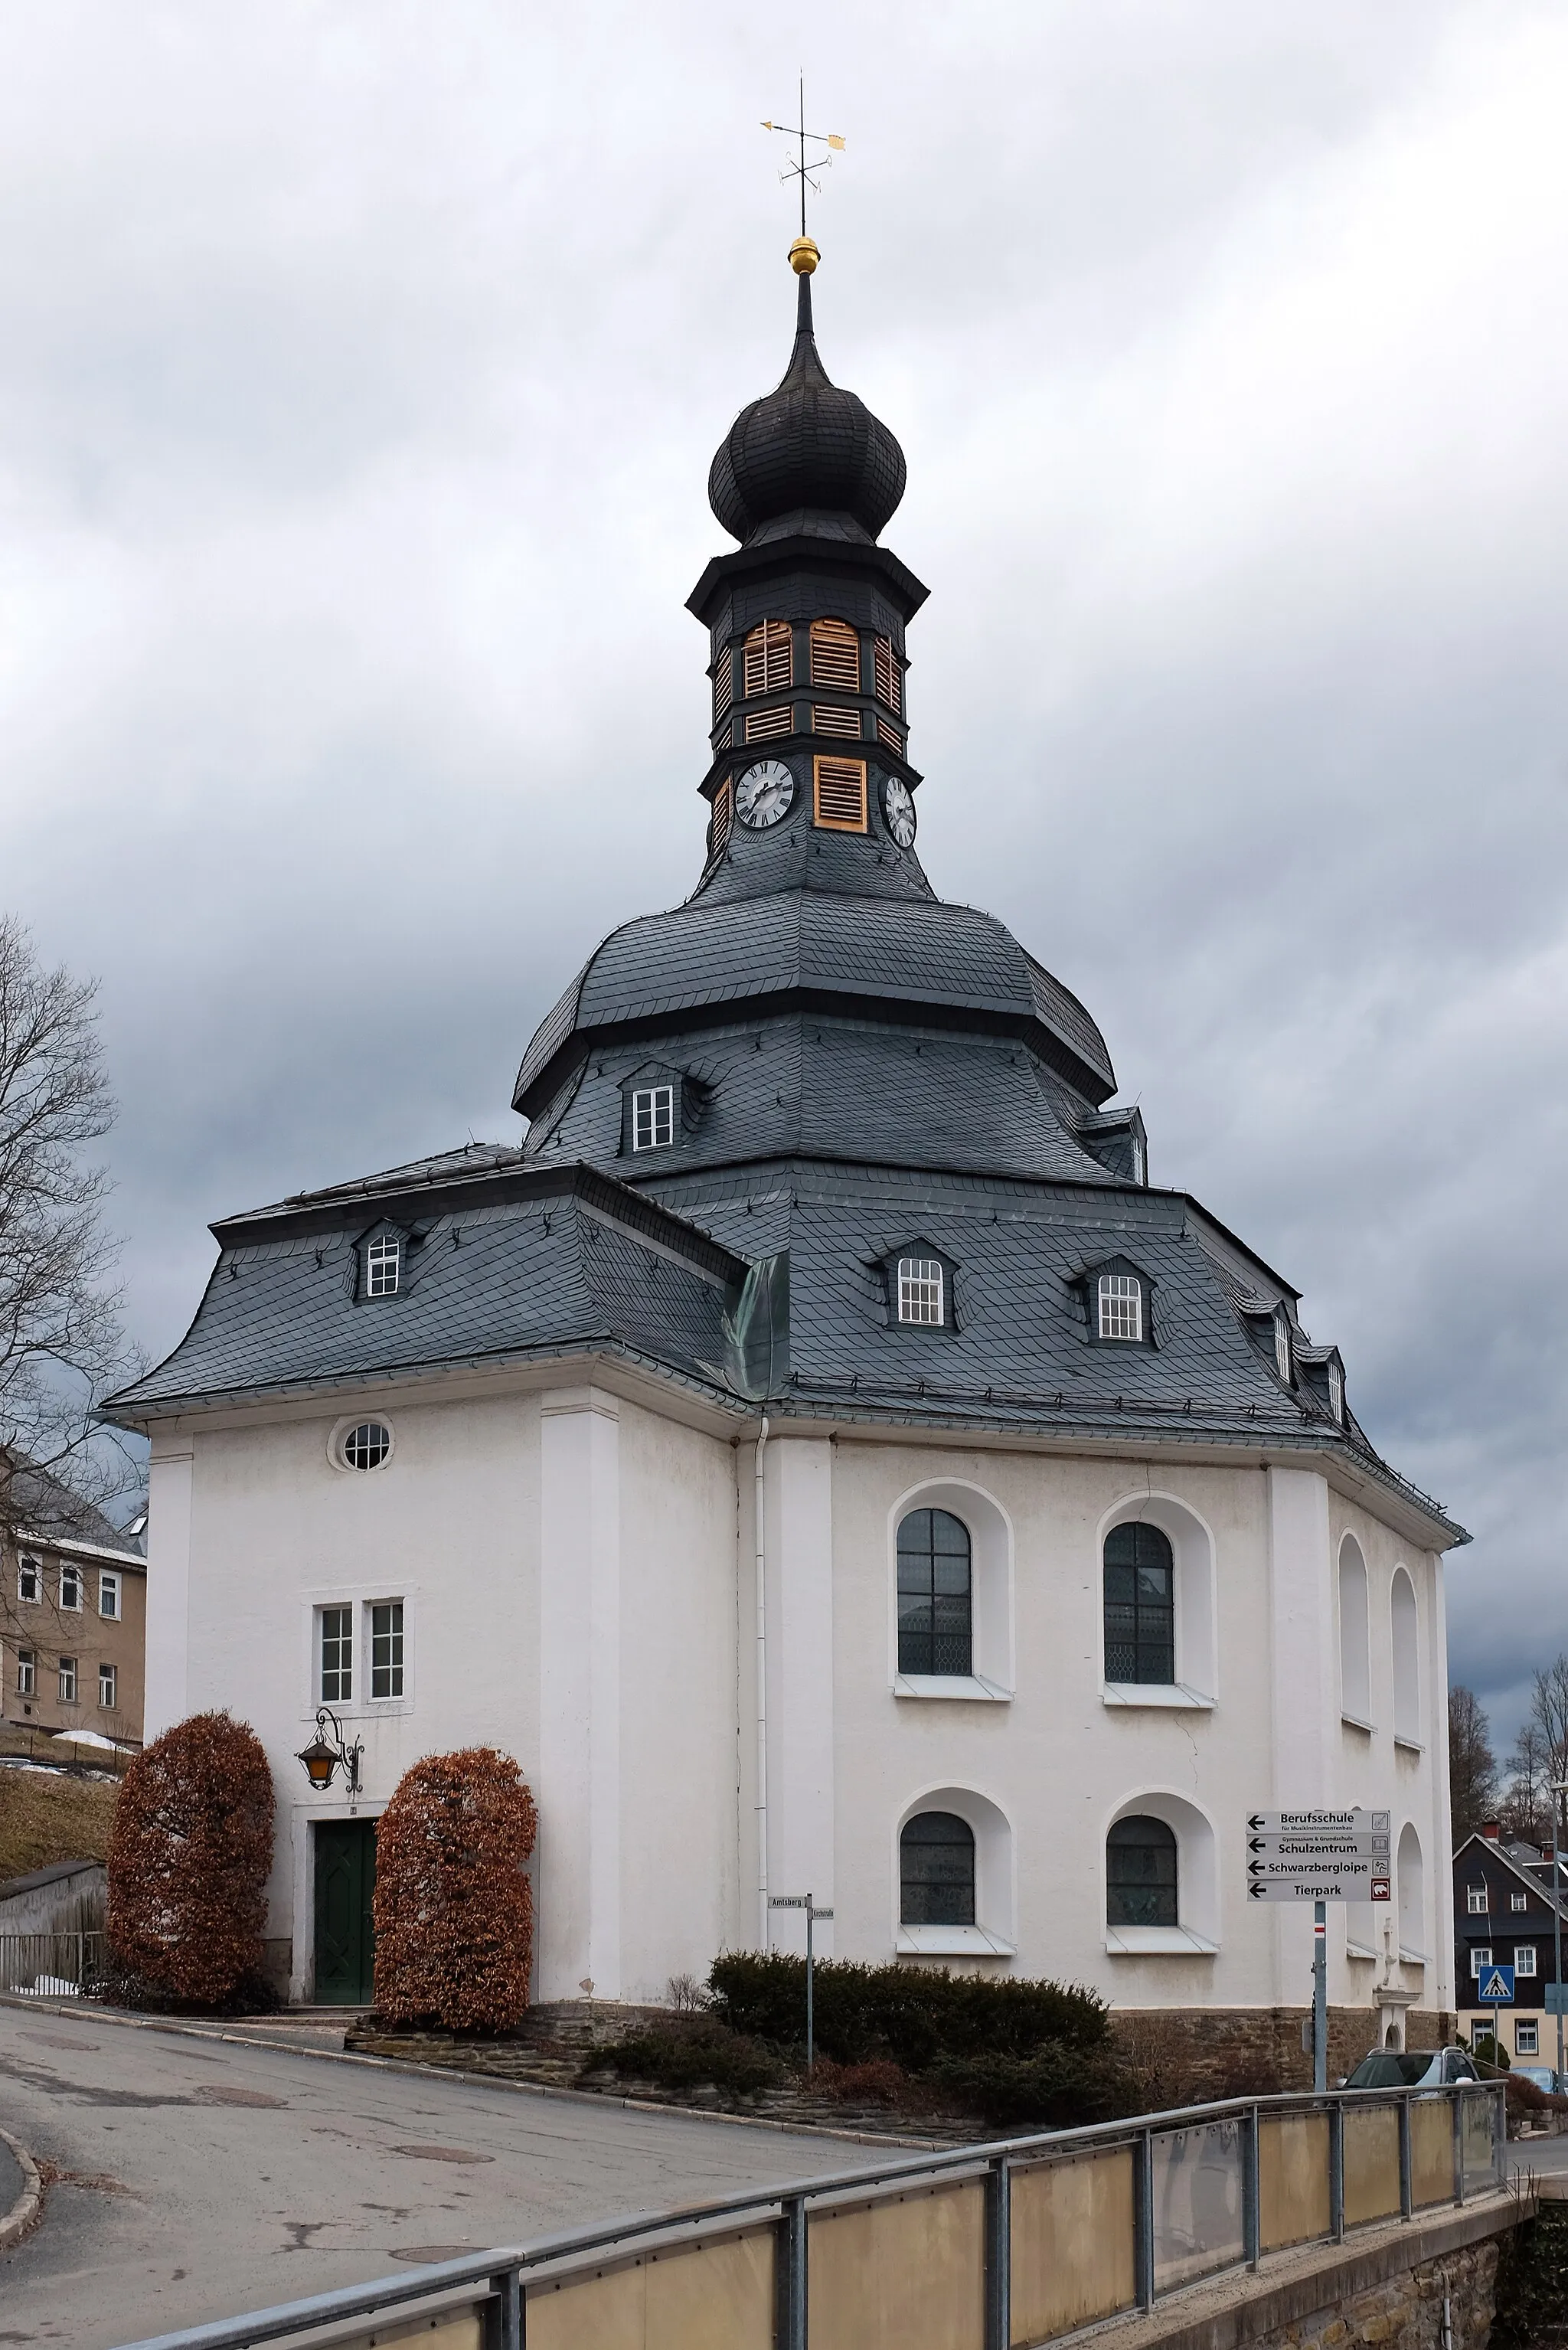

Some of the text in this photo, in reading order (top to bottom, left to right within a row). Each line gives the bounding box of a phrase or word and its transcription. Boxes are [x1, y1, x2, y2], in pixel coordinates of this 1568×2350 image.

[1280, 1812, 1354, 1823] Berufsschule
[1279, 1844, 1357, 1854] Schulzentrum
[1268, 1861, 1368, 1874] Schwarzbergloipe
[1295, 1884, 1341, 1897] Tierpark
[773, 1898, 802, 1907] Amtsberg
